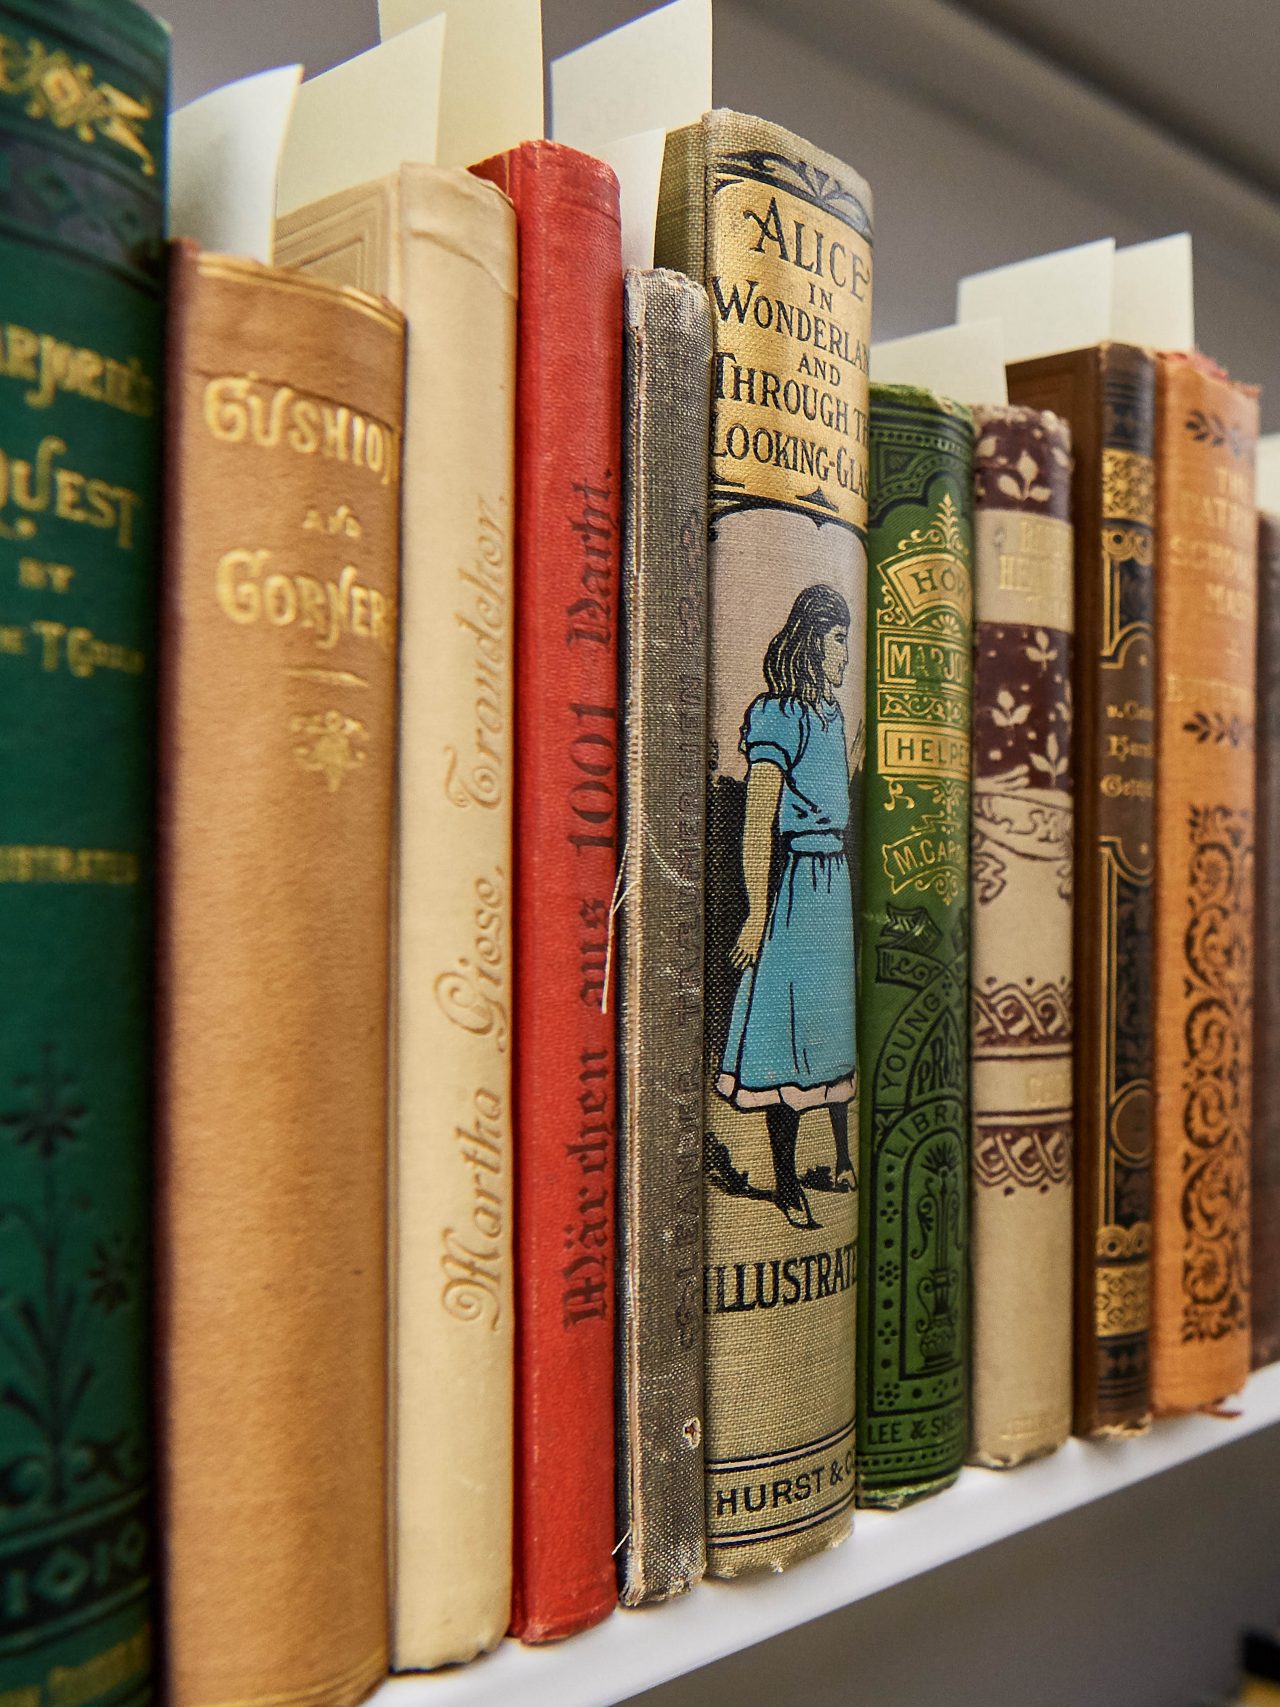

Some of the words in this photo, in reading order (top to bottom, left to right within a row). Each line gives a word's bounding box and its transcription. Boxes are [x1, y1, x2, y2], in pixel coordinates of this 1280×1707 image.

[743, 196, 870, 303] ALICE
[808, 282, 834, 314] IN
[714, 351, 849, 437] THROUGH
[797, 352, 841, 387] AND
[567, 701, 616, 858] 1001
[578, 898, 609, 1009] aus
[880, 993, 941, 1091] YOUNG
[440, 1087, 503, 1332] Martha
[562, 1048, 613, 1331] Märchen
[867, 1421, 903, 1446] LEE
[716, 1467, 825, 1517] HURST
[830, 1459, 844, 1486] &
